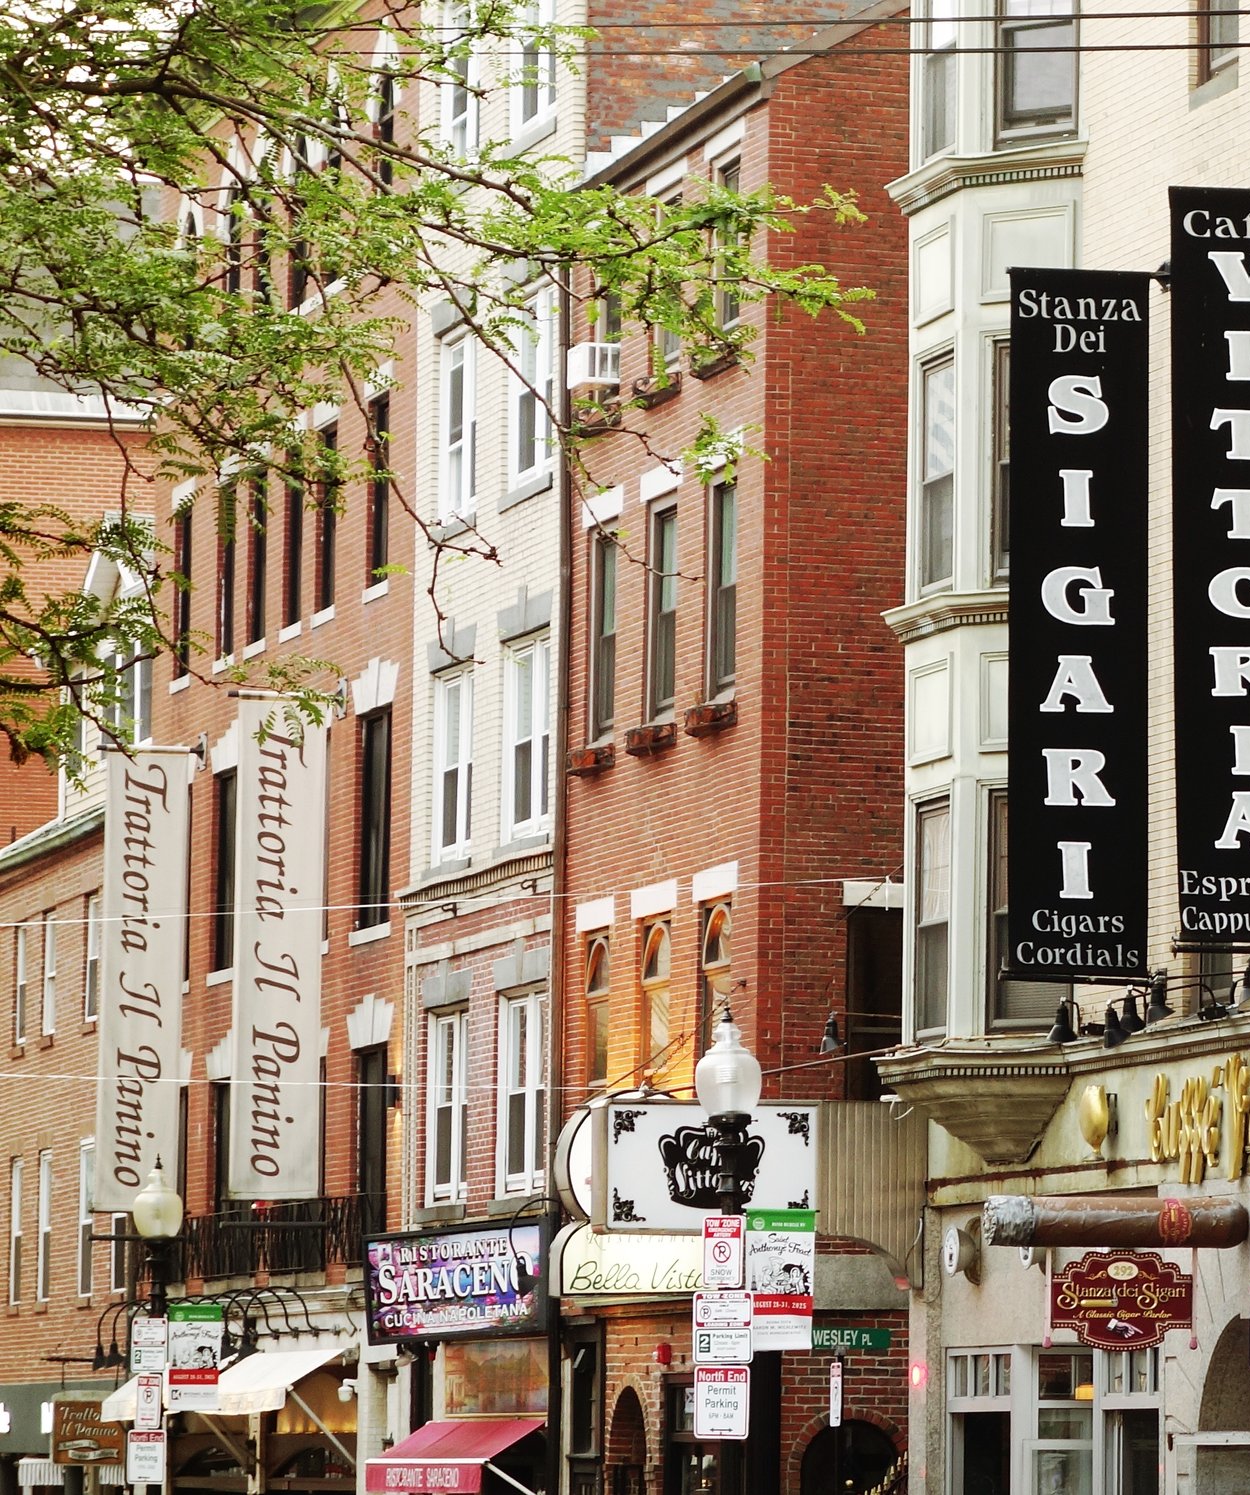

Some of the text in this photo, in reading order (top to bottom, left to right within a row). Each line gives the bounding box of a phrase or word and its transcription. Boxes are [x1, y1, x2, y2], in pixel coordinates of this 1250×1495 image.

[1017, 288, 1143, 322] Stanza
[1052, 323, 1107, 354] Dei
[1039, 374, 1117, 900] SIGARI
[120, 763, 170, 953] Trattoria
[1030, 908, 1125, 938] Cigars
[1015, 941, 1140, 970] Cordials
[250, 1021, 302, 1178] Panino
[113, 1044, 163, 1188] Panino
[705, 1219, 741, 1228] TOW ZONE
[399, 1237, 508, 1265] RISTORANTE
[378, 1251, 535, 1306] SARACENO
[569, 1260, 642, 1291] Bella
[710, 1268, 733, 1276] SNOW
[1112, 1264, 1134, 1276] 292
[1056, 1281, 1186, 1310] Stanza dei Sigari
[384, 1303, 530, 1328] CUCINA NAPOLETANA
[1072, 1309, 1173, 1321] A Classic Cigar Parlor
[700, 1335, 710, 1348] 2
[812, 1329, 873, 1347] WESLEY PL
[698, 1370, 747, 1382] North End
[707, 1384, 737, 1395] Permit
[704, 1398, 739, 1411] Parking
[130, 1433, 164, 1441] North End
[136, 1444, 157, 1452] Permit
[134, 1454, 158, 1464] Parking
[385, 1467, 460, 1488] RISTORANTE SARACENO
